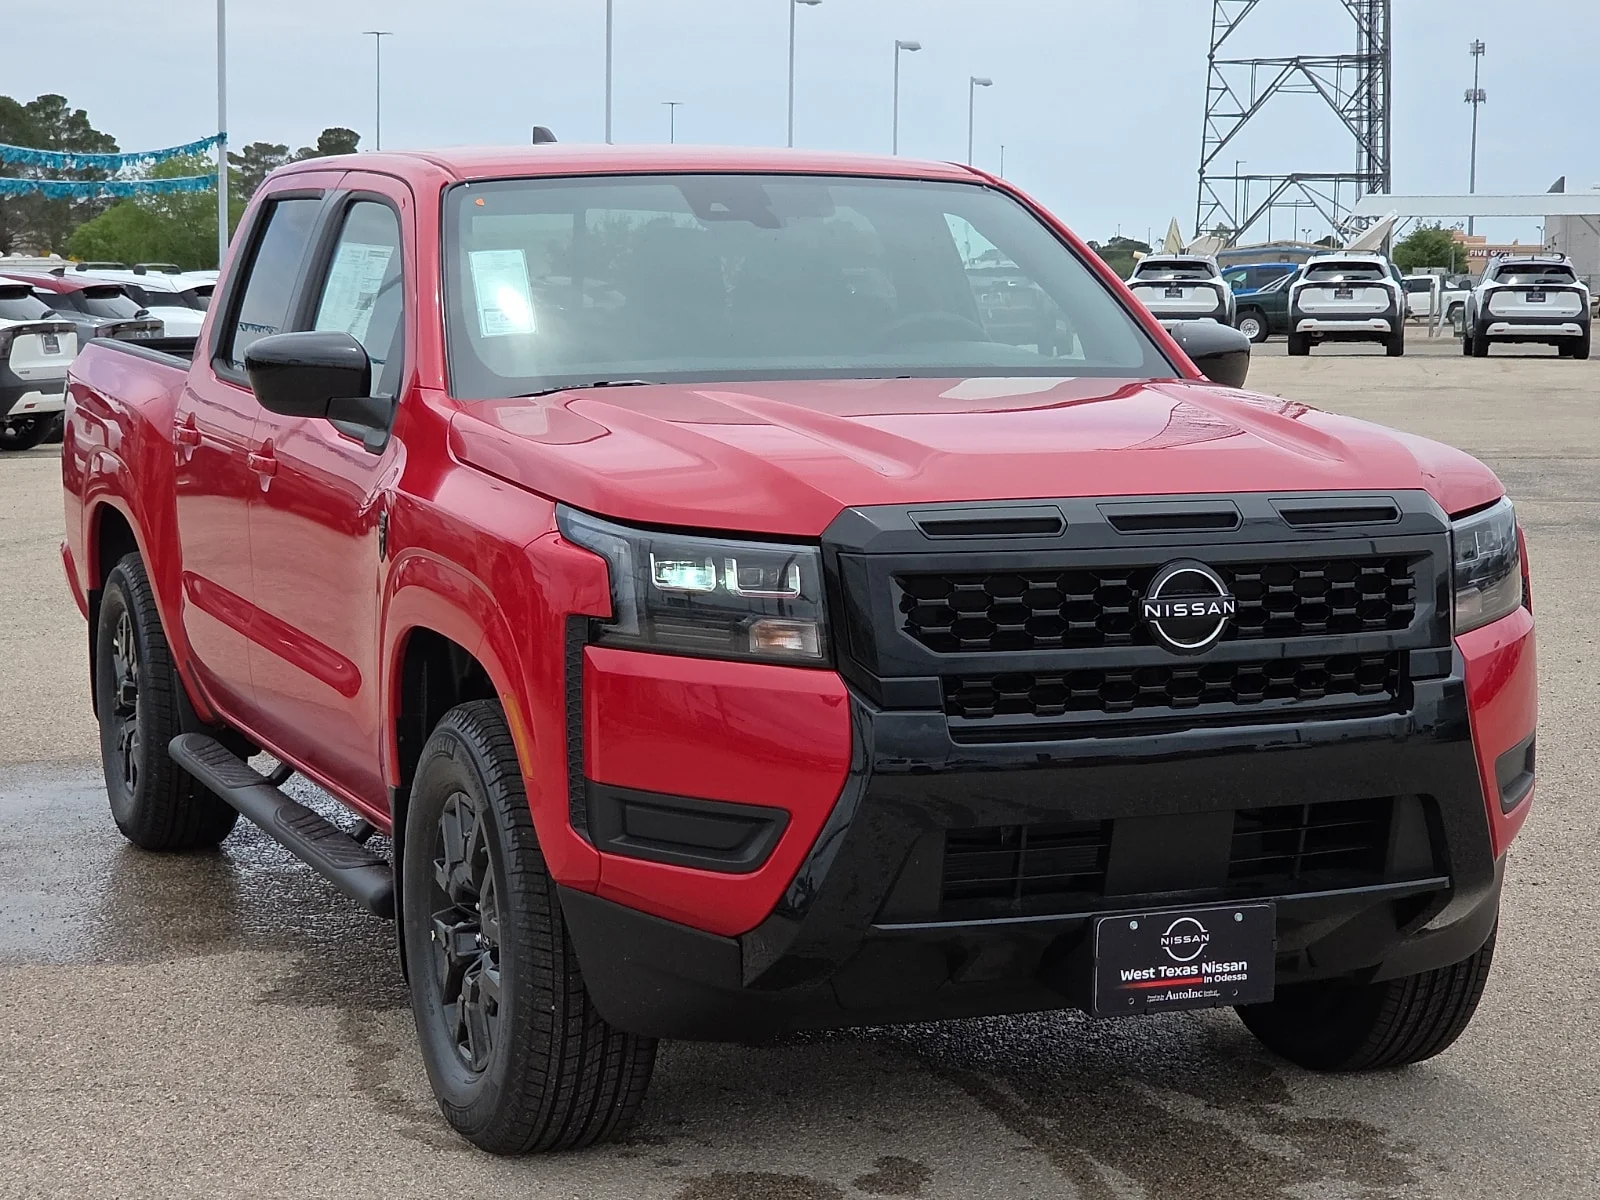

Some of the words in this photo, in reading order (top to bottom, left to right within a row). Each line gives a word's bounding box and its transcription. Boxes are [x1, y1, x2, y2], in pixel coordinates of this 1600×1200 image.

[1144, 601, 1235, 618] NISSAN
[1160, 933, 1210, 946] NISSAN
[1120, 967, 1156, 982] West
[1158, 964, 1199, 978] Texas
[1201, 960, 1247, 974] Nissan
[1214, 973, 1248, 983] Odessa
[1165, 988, 1204, 1001] AutoInc
